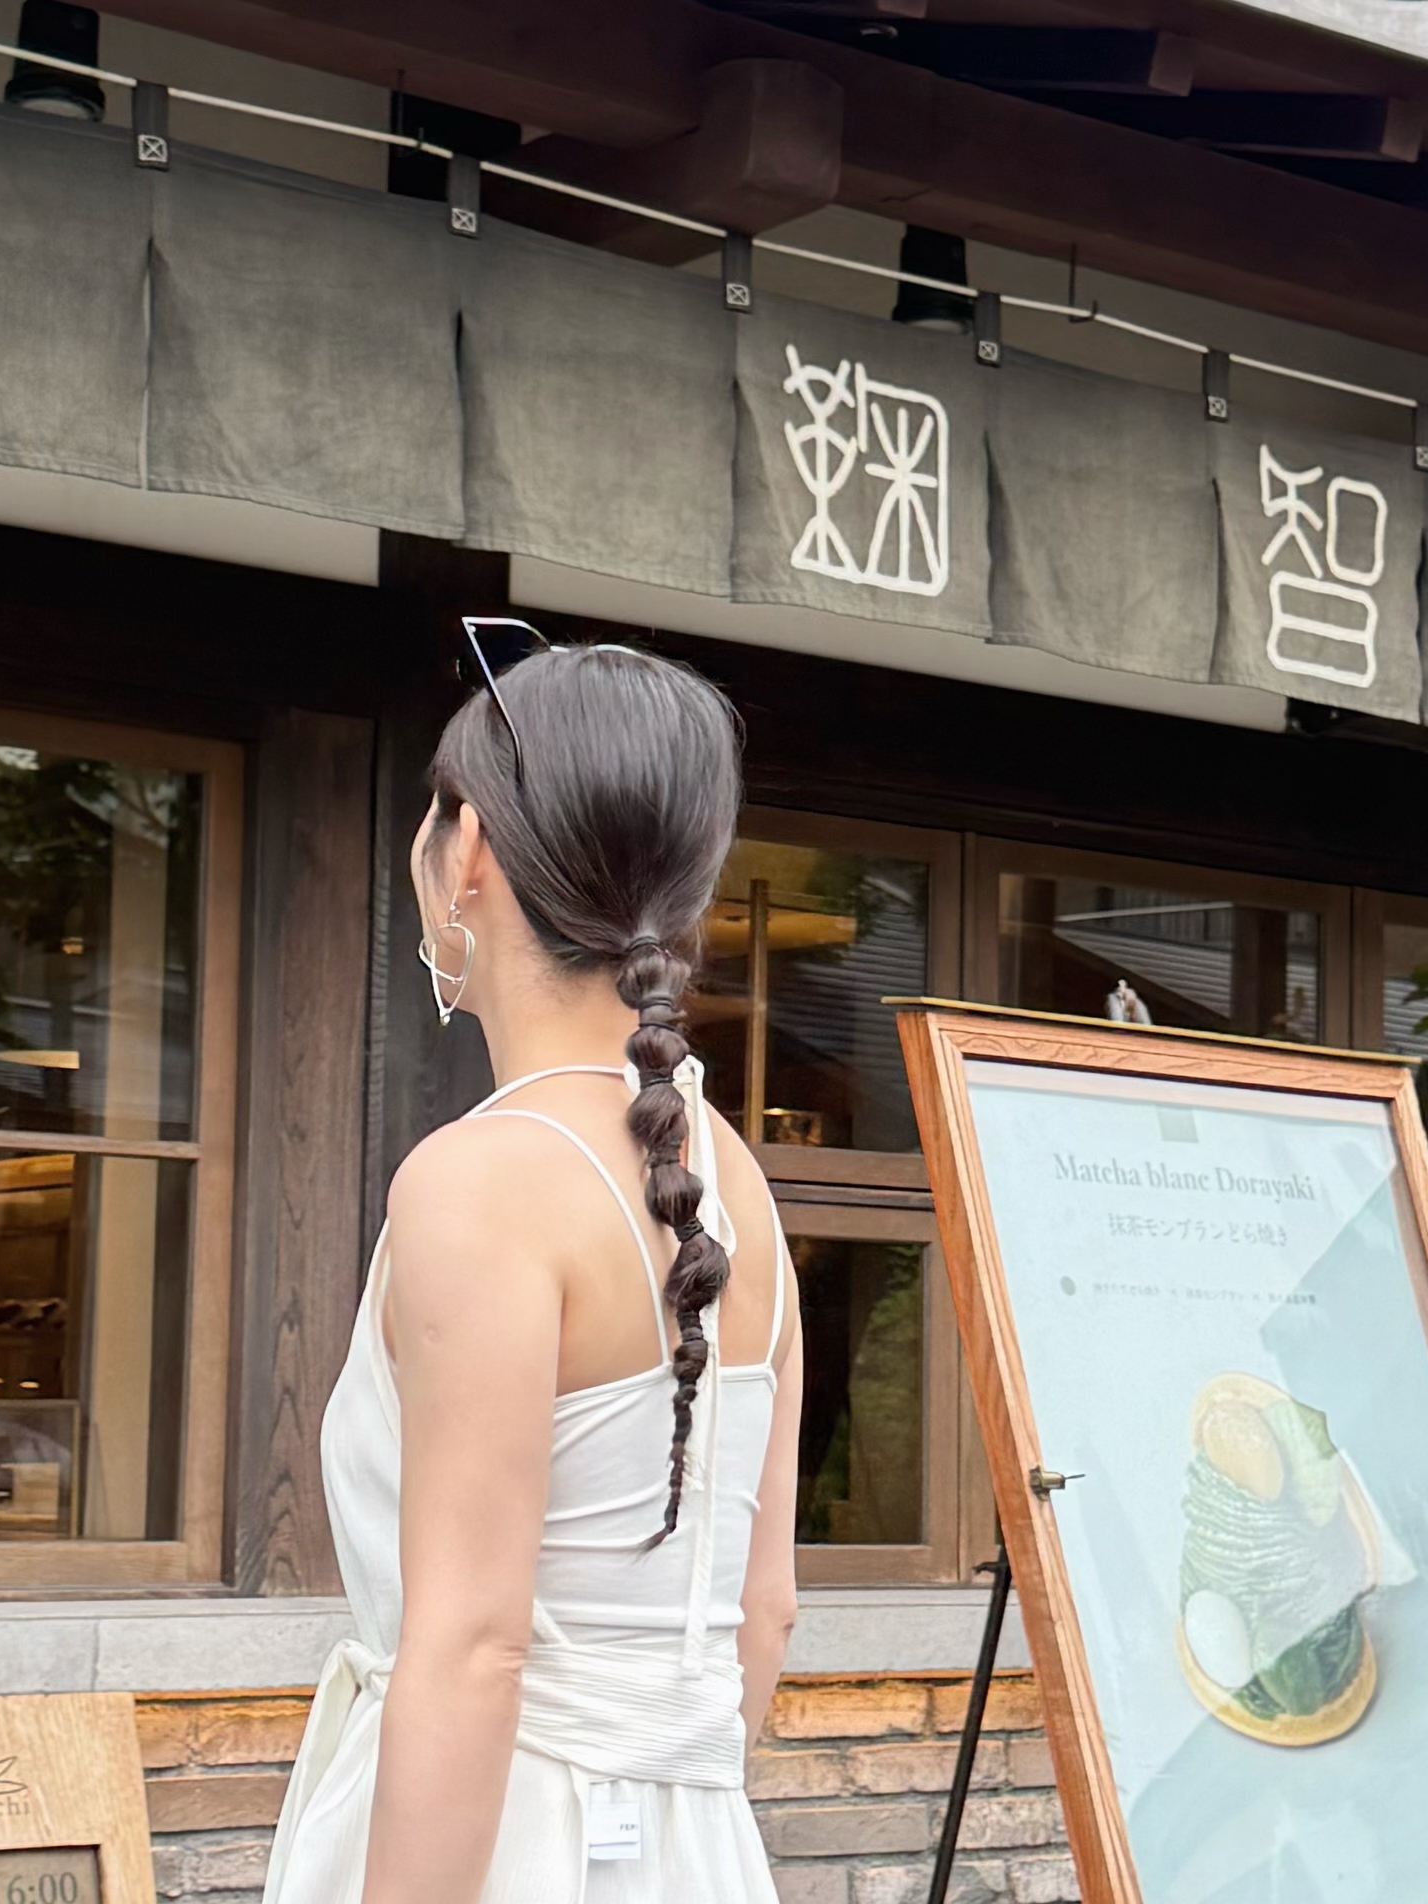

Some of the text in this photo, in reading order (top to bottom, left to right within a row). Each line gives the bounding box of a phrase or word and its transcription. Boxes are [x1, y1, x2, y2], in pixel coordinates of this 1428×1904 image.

[1053, 1153, 1317, 1204] Matcha blanc Dorayaki
[1108, 1212, 1288, 1247] 抹茶モンブランどら焼き
